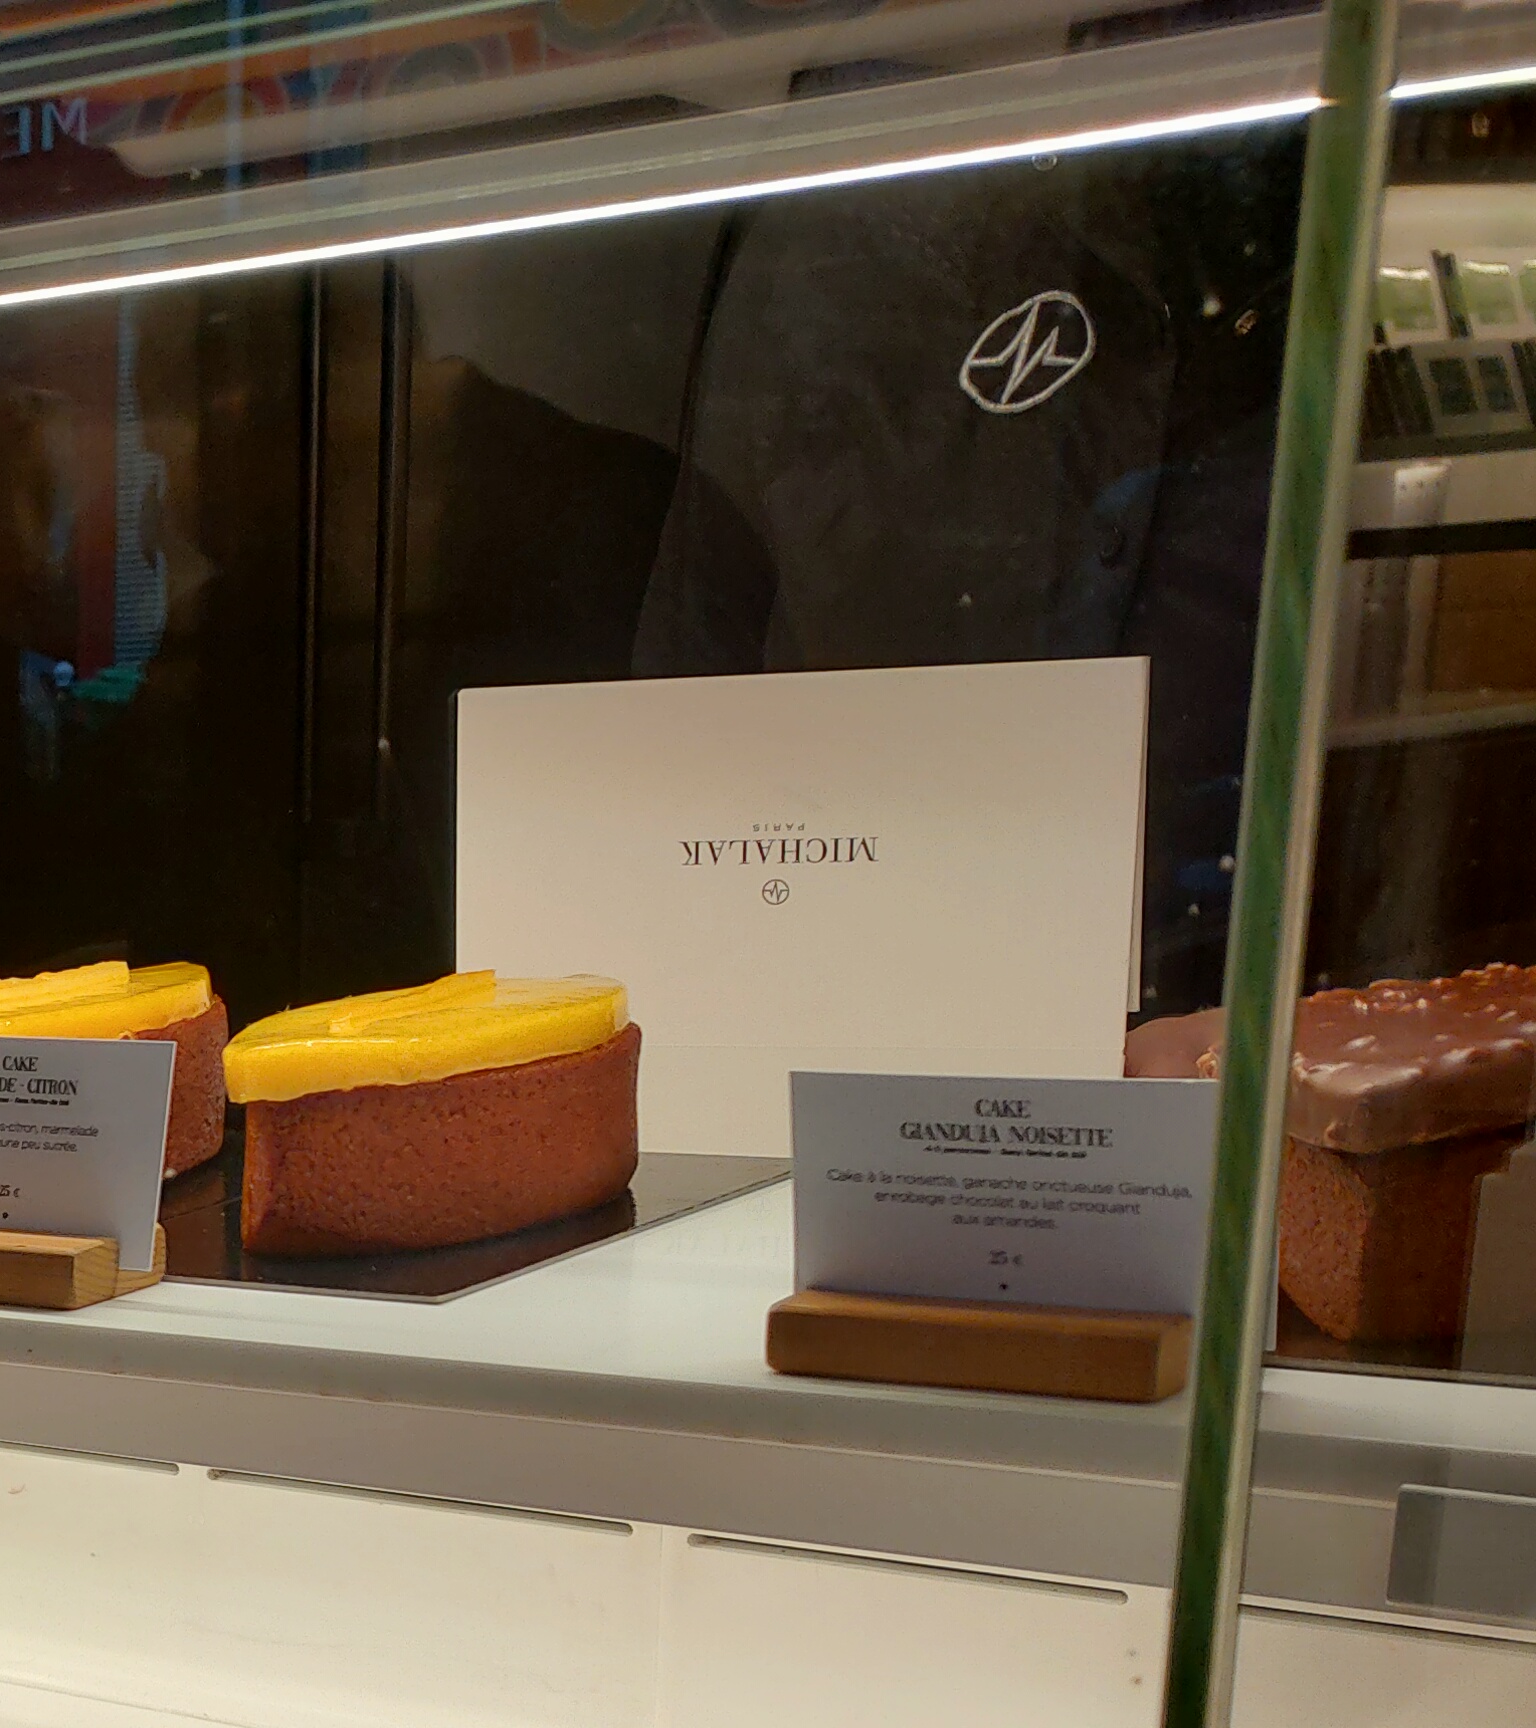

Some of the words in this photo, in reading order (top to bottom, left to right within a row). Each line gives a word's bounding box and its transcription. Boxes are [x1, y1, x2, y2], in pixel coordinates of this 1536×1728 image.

[753, 823, 805, 832] PARIS
[678, 836, 879, 866] MICHALAK
[1, 1054, 39, 1071] CAKE
[26, 1078, 77, 1095] CITRON
[973, 1098, 1031, 1119] CAKE
[40, 1124, 99, 1137] marmelade
[1008, 1125, 1112, 1147] NOISETTE
[20, 1139, 41, 1150] peu
[826, 1167, 864, 1183] Cake
[961, 1176, 1027, 1191] ganache
[1031, 1180, 1114, 1194] onctueuse
